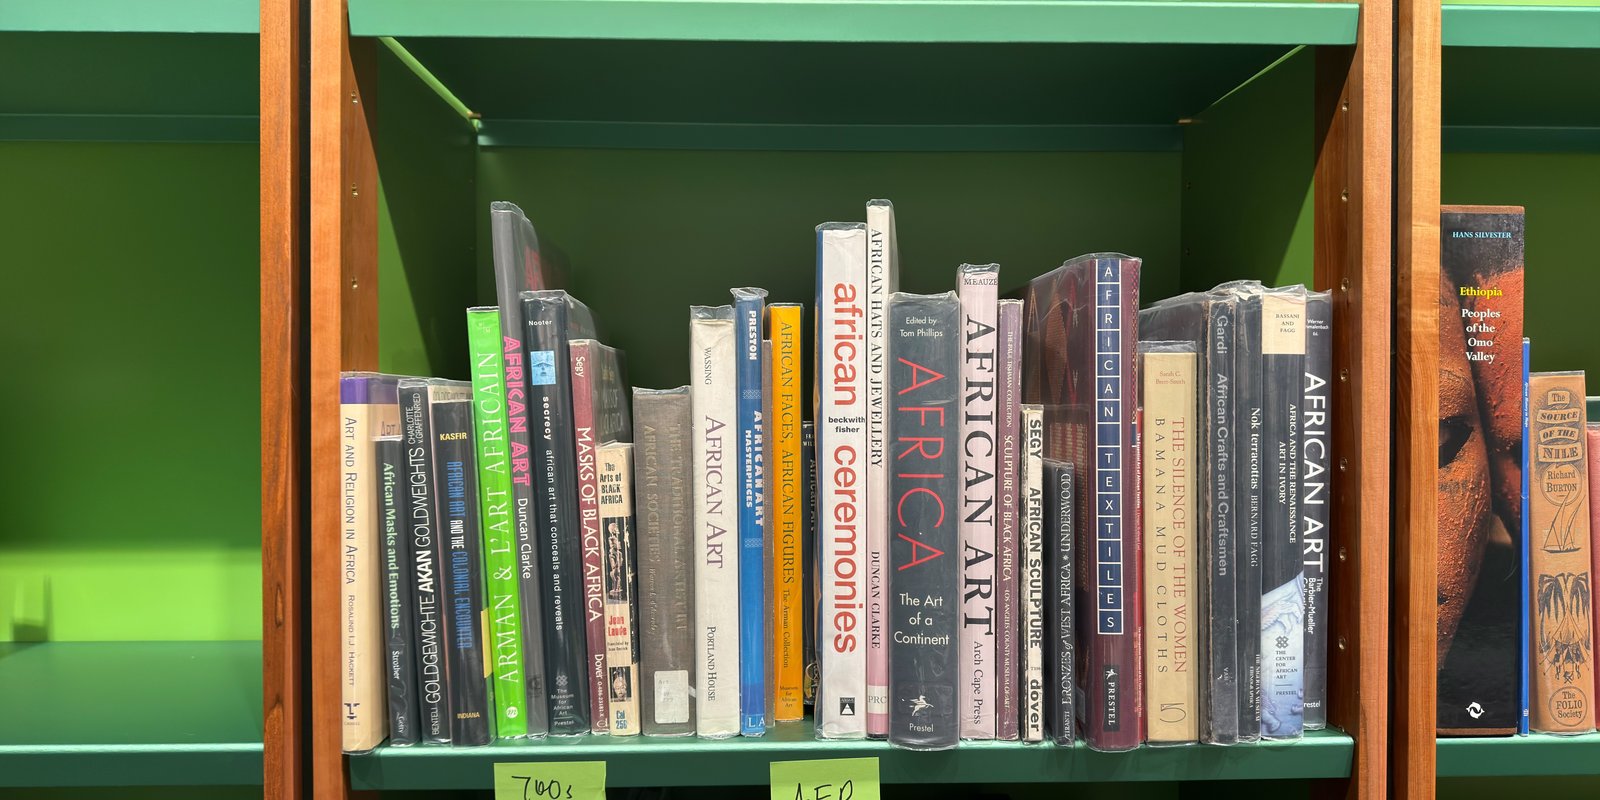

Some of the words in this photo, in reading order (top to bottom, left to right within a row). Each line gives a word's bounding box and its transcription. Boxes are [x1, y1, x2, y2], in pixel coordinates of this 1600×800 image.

[871, 229, 882, 294] AFRICAN
[1460, 287, 1502, 300] Ethiopia
[871, 300, 882, 338] HATS
[916, 330, 943, 338] Phillips
[928, 317, 936, 326] by
[1462, 309, 1500, 322] Peoples
[1466, 324, 1478, 332] of
[1478, 324, 1495, 332] the
[749, 310, 757, 360] PRESTON
[834, 283, 863, 406] african
[1104, 267, 1114, 416] AFRICAN
[1216, 316, 1228, 354] Gardi
[1468, 338, 1493, 346] Omo
[575, 356, 586, 378] Segy
[781, 322, 793, 387] AFRICAN
[871, 344, 882, 373] AND
[1466, 352, 1495, 364] Valley
[504, 336, 526, 432] AFRICAN
[1218, 374, 1228, 424] African
[1552, 394, 1565, 402] The
[345, 418, 357, 440] ART
[406, 406, 416, 444] CHARLOTTE
[477, 352, 504, 474] AFRICAIN
[542, 396, 552, 440] secrecy
[779, 394, 794, 443] FACES,
[870, 378, 882, 468] JEWELLERY
[964, 314, 995, 526] AFRICAN
[1251, 408, 1260, 429] Nok
[1540, 411, 1578, 421] SOURCE
[440, 432, 466, 440] KASFIR
[754, 411, 764, 488] AFRICAN
[1030, 420, 1042, 458] SEGY
[1172, 418, 1185, 452] THE
[1217, 426, 1228, 470] Crafts
[1304, 372, 1326, 504] AFRICAN
[1543, 430, 1554, 438] OF
[1558, 429, 1575, 438] THE
[346, 446, 354, 467] AND
[510, 442, 530, 486] ART
[546, 450, 554, 483] african
[577, 428, 595, 480] MASKS
[706, 416, 726, 516] AFRICAN
[898, 358, 945, 570] AFRICA
[1004, 435, 1012, 490] SCULPTURE
[1156, 418, 1165, 511] BAMANA
[1251, 432, 1260, 490] terracottas
[1542, 447, 1578, 459] NILE
[384, 463, 396, 506] African
[448, 462, 464, 499] AFRICAN
[582, 485, 596, 504] OF
[602, 484, 620, 494] BLACK
[782, 450, 794, 515] AFRICAN
[1172, 458, 1186, 530] SILENCE
[1218, 474, 1228, 500] and
[1546, 483, 1577, 492] BURTON
[1548, 471, 1576, 480] Richard
[346, 473, 357, 523] RELIGION
[409, 448, 432, 548] GOLDWEIGHTS
[449, 502, 466, 516] ART
[600, 494, 623, 505] AFRICA
[756, 493, 764, 526] ART
[1004, 494, 1012, 508] OF
[1060, 474, 1072, 552] UNDERWOOD
[346, 530, 354, 539] IN
[386, 509, 396, 536] Masks
[450, 520, 463, 534] AND
[487, 487, 510, 554] L'ART
[518, 498, 528, 540] Duncan
[582, 510, 600, 558] BLACK
[1003, 512, 1012, 544] BLACK
[1030, 488, 1042, 552] AFRICAN
[386, 540, 398, 570] and
[451, 535, 464, 549] THE
[551, 526, 560, 570] conceals
[706, 524, 727, 568] ART
[783, 522, 794, 584] FIGURES
[834, 446, 863, 653] ceremonies
[1104, 454, 1114, 628] TEXTILES
[1156, 526, 1166, 572] MUD
[1173, 536, 1186, 556] OF
[1218, 502, 1229, 576] Craftsmen
[1304, 516, 1324, 572] ART
[346, 545, 357, 584] AFRICA
[416, 550, 434, 592] AKAN
[452, 551, 470, 594] COLONIAL
[493, 566, 512, 580] &
[521, 544, 532, 579] Clarke
[871, 552, 880, 600] DUNCAN
[1003, 547, 1012, 581] AFRICA
[553, 574, 562, 592] and
[586, 563, 603, 622] AFRICA
[900, 593, 920, 606] The
[924, 595, 943, 606] Art
[964, 540, 994, 636] ART
[1060, 563, 1071, 606] AFRICA
[1173, 564, 1186, 598] THE
[388, 574, 400, 629] Emotions
[554, 595, 562, 630] reveals
[608, 616, 624, 625] Jean
[909, 613, 922, 625] of
[924, 618, 932, 626] a
[1030, 558, 1042, 648] SCULPTURE
[455, 598, 472, 649] ENCOUNTER
[494, 594, 518, 682] ARMAN
[608, 626, 627, 636] Laude
[871, 603, 881, 649] CLARKE
[894, 632, 950, 645] Continent
[1060, 609, 1072, 639] WEST
[1156, 586, 1168, 672] CLOTHS
[1174, 605, 1187, 672] WOMEN
[420, 594, 440, 703] GOLDGEWICHTE
[707, 626, 716, 669] PORTLAND
[973, 642, 983, 666] Arch
[1065, 640, 1074, 650] of
[708, 672, 717, 701] HOUSE
[972, 669, 984, 695] Cape
[1062, 651, 1072, 704] BRONZES
[1562, 692, 1576, 700] The
[973, 698, 984, 724] Press
[1030, 679, 1041, 732] dover
[1556, 700, 1582, 710] FOLIO
[1558, 710, 1582, 719] Society
[910, 723, 934, 732] Prestel
